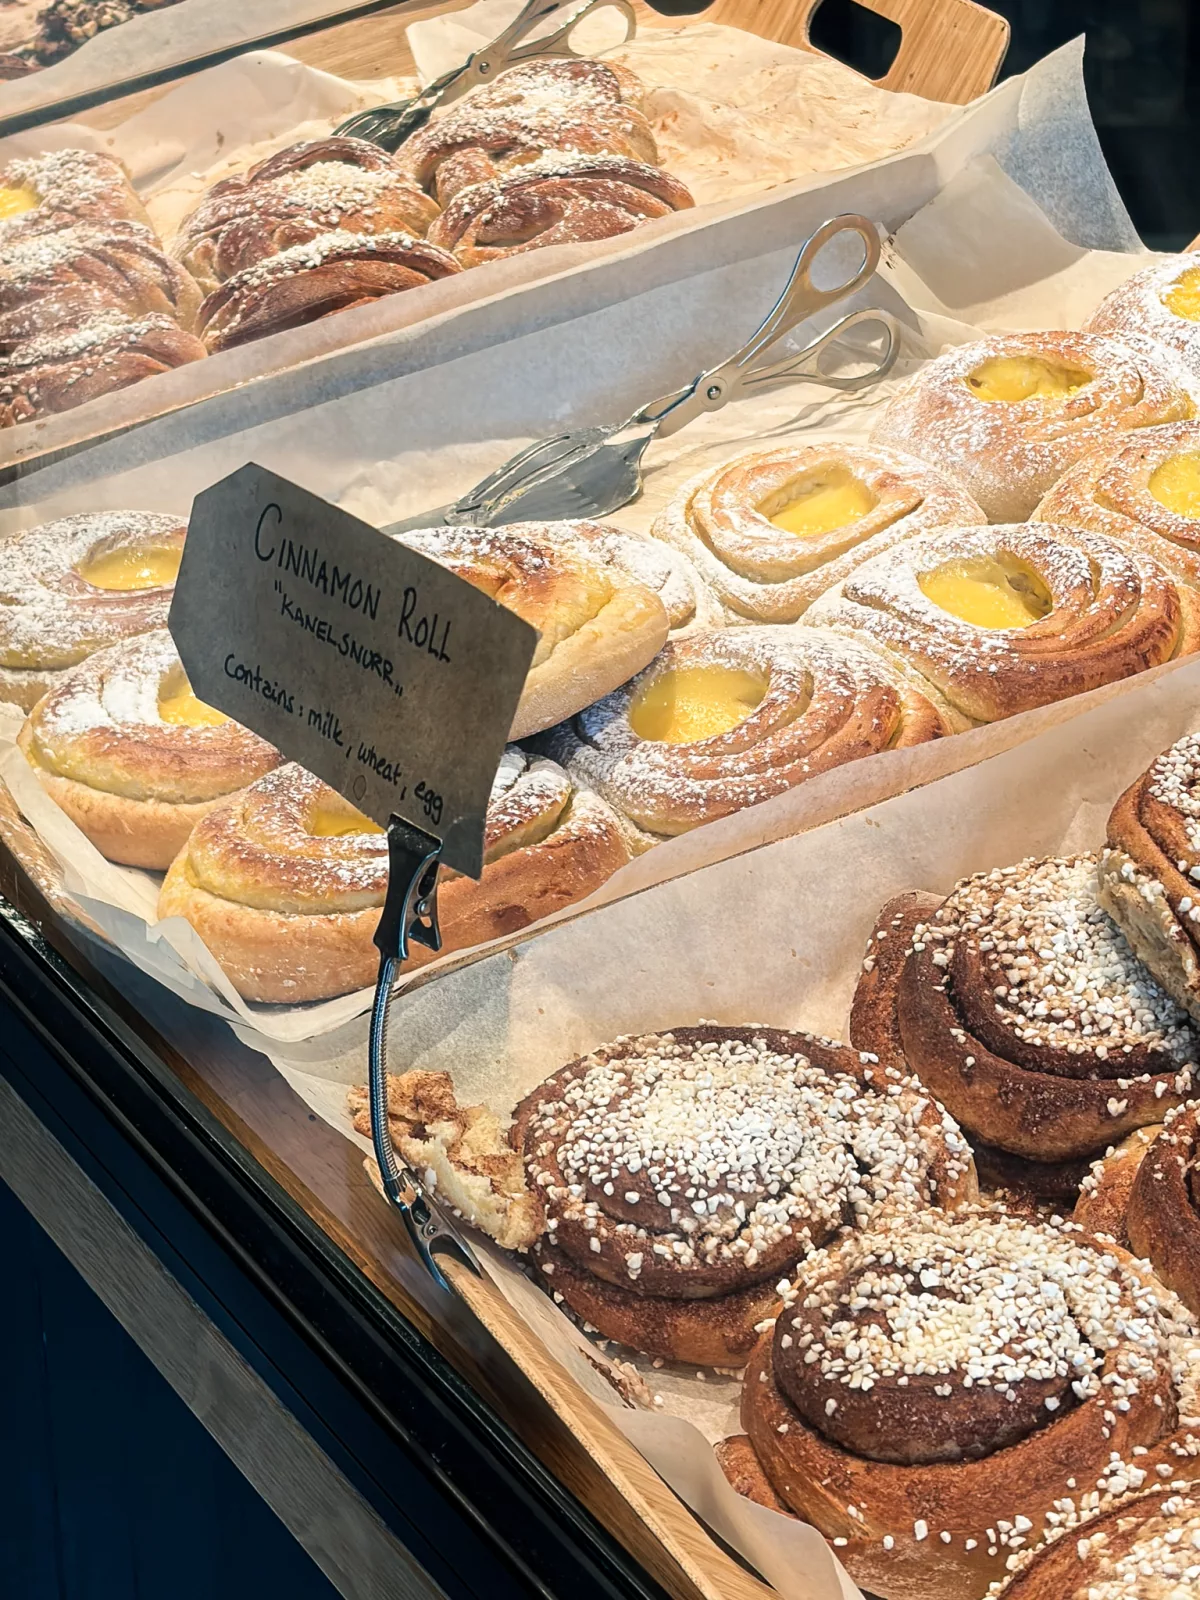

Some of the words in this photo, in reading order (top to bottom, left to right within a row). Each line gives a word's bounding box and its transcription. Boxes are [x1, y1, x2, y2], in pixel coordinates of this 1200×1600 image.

[254, 502, 381, 621] CINNAMON
[399, 587, 452, 664] ROLL
[414, 780, 444, 826] egg
